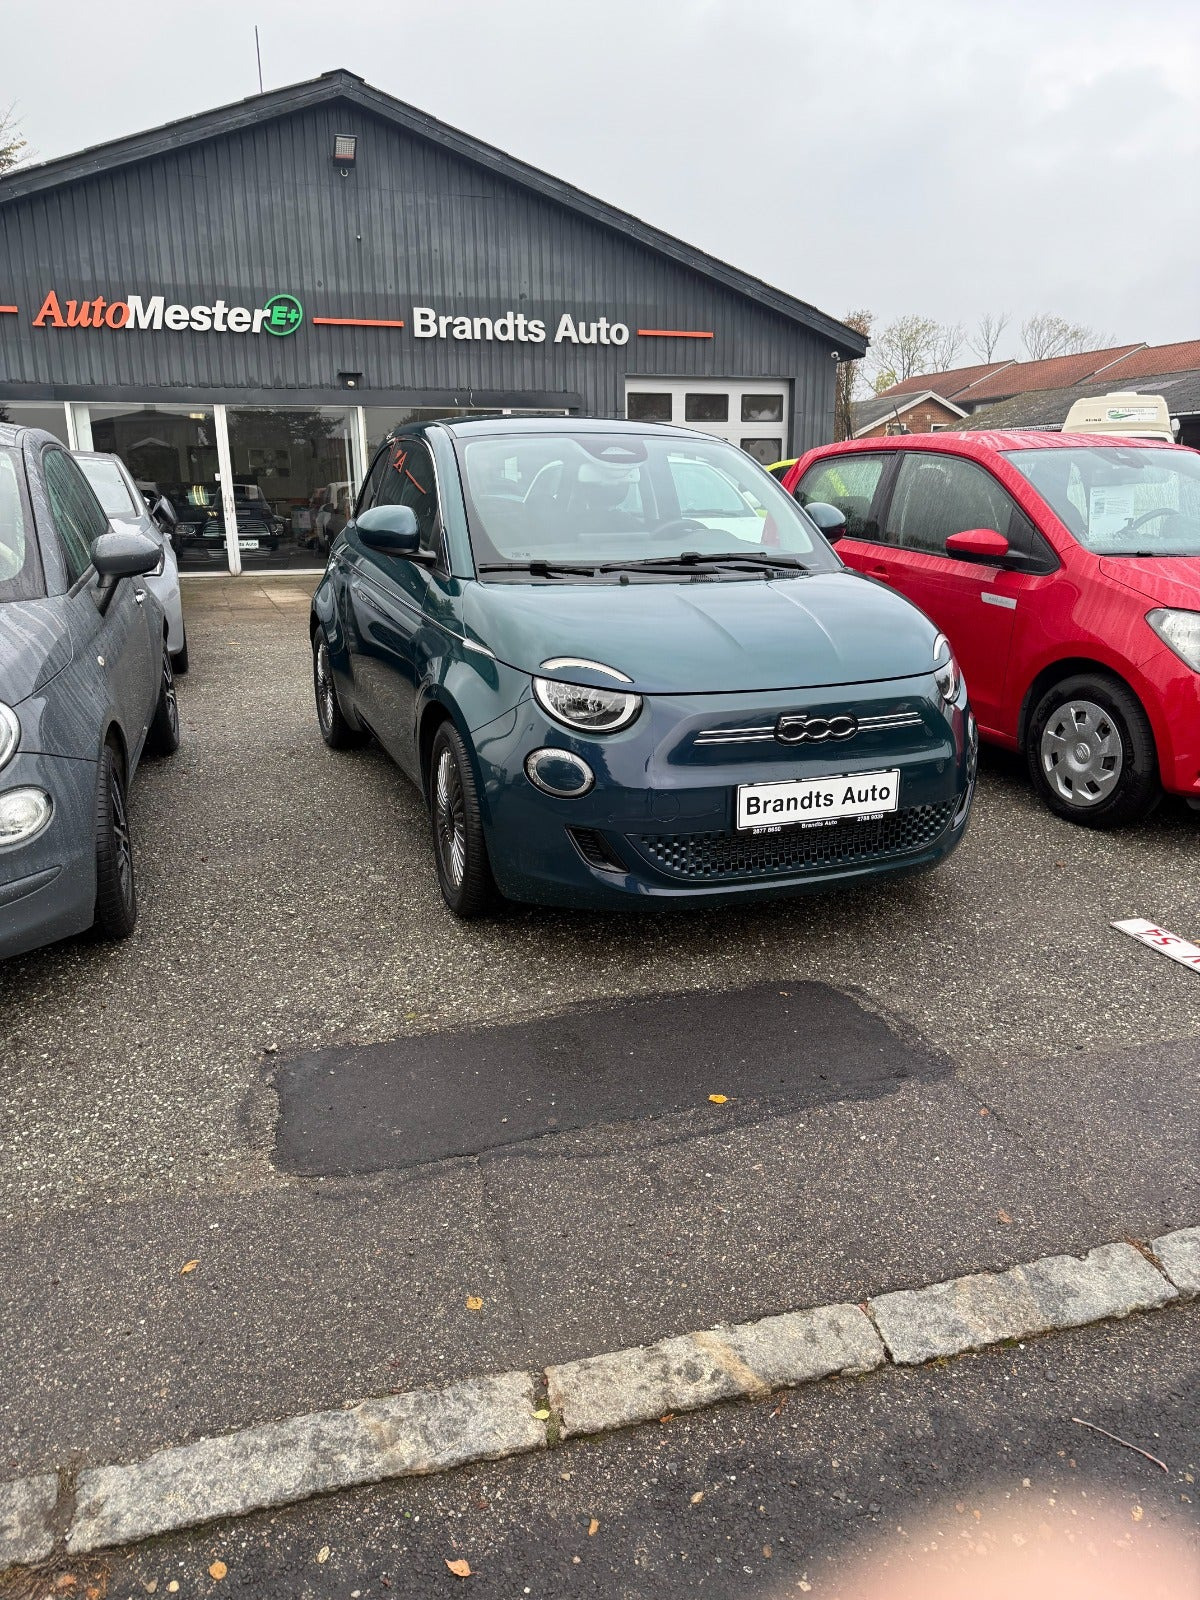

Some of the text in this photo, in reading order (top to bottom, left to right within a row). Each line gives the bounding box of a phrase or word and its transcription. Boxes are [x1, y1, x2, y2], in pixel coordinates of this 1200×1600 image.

[32, 290, 270, 333] AutoMester
[413, 307, 630, 346] Brandts Auto
[777, 714, 857, 742] 500
[746, 785, 891, 815] Brandts Auto
[801, 821, 824, 829] Brandts
